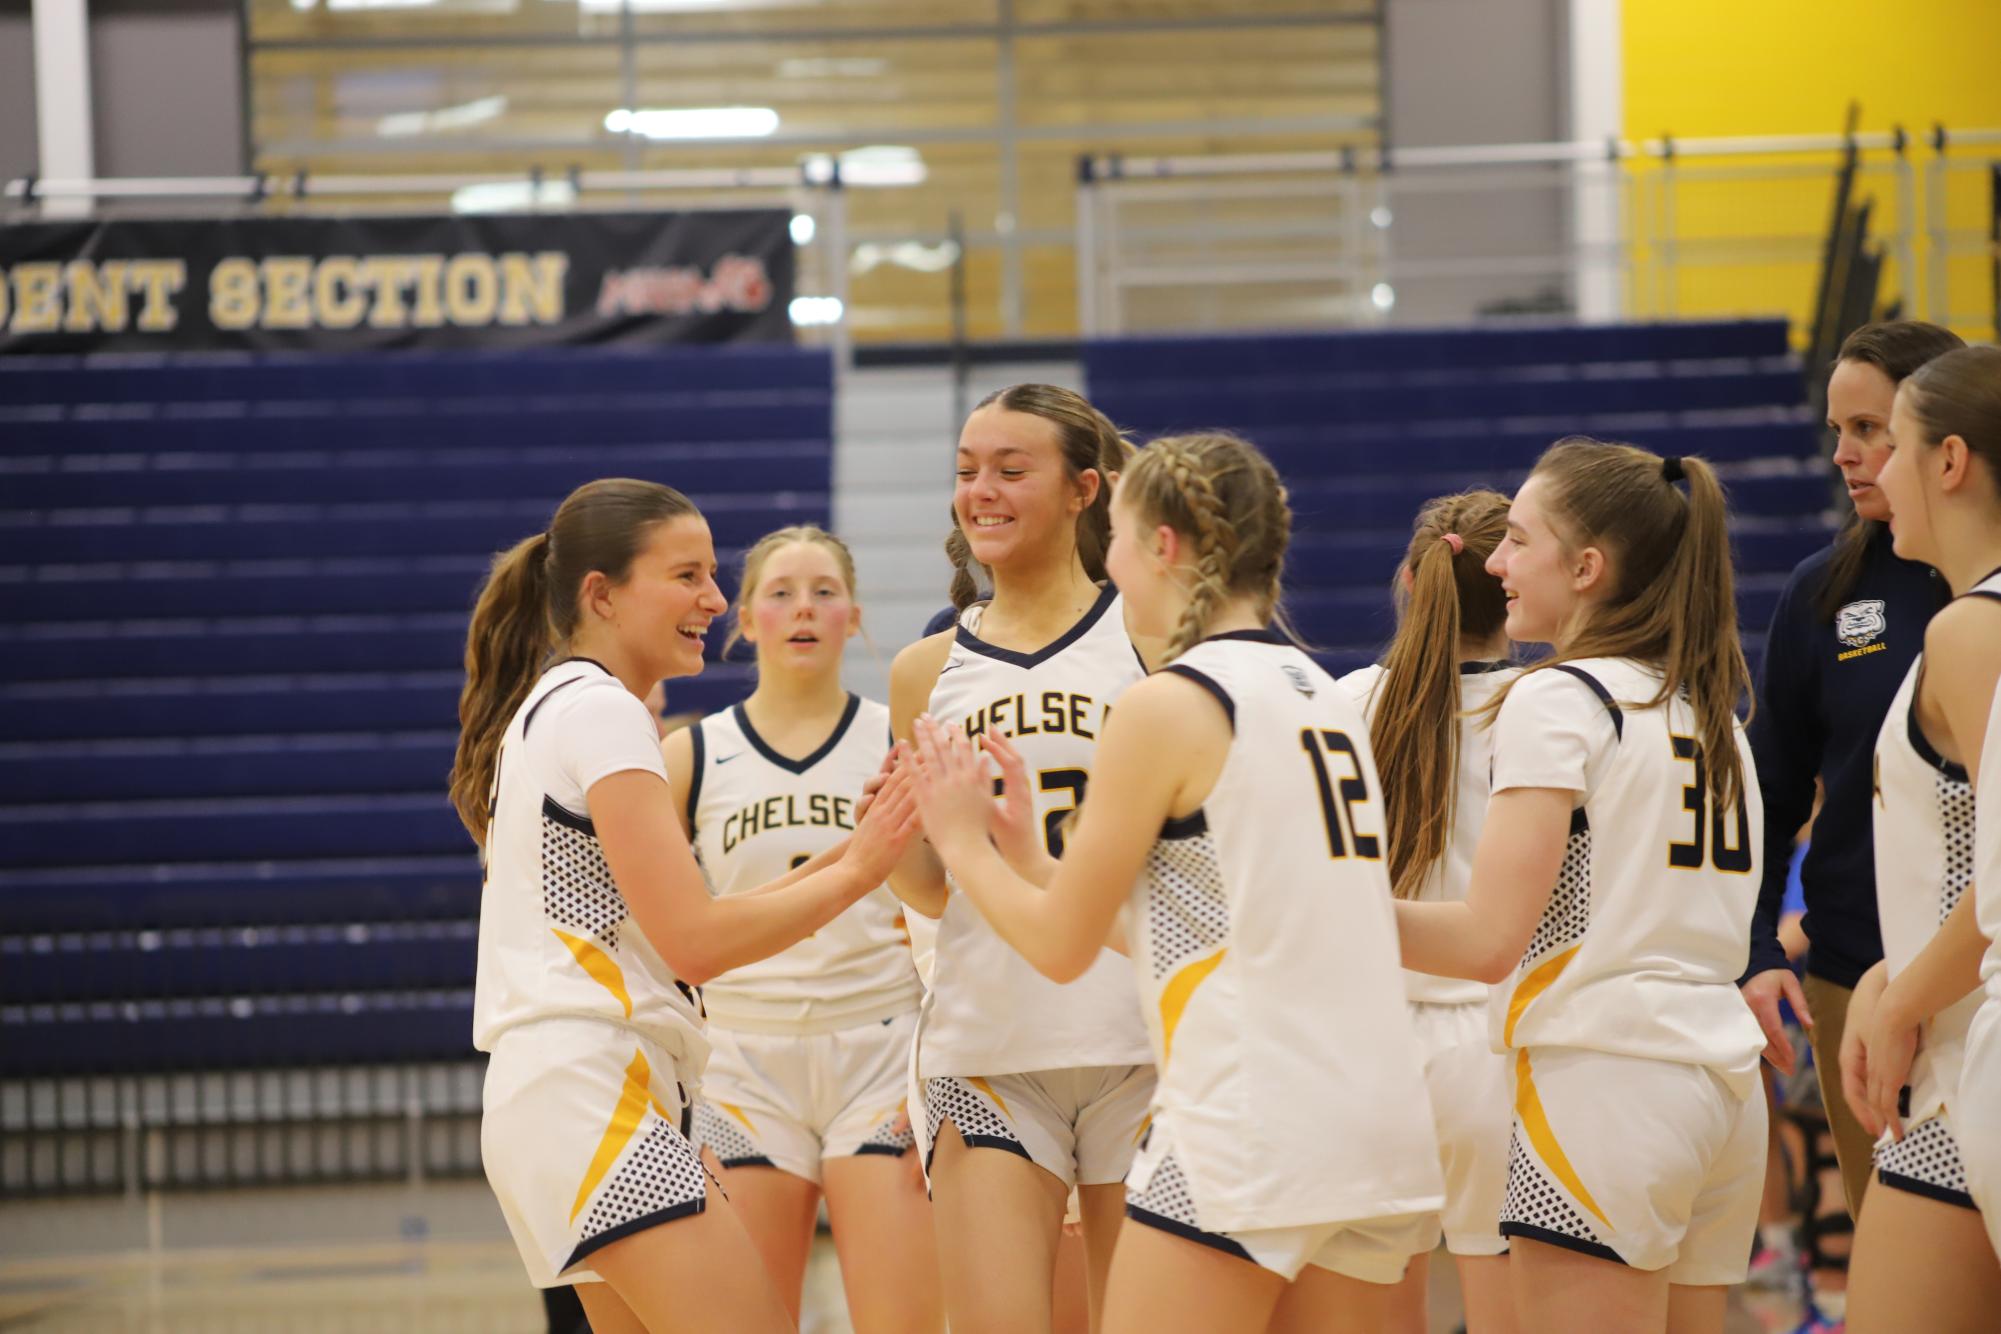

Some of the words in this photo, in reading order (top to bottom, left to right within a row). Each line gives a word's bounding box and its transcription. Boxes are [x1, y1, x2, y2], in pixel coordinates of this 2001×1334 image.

[209, 253, 568, 331] SECTION
[1837, 641, 1887, 661] BASKETBALL
[958, 690, 1112, 752] HELSE
[722, 793, 856, 855] CHELSE
[1300, 728, 1381, 860] 12
[1667, 733, 1753, 875] 30
